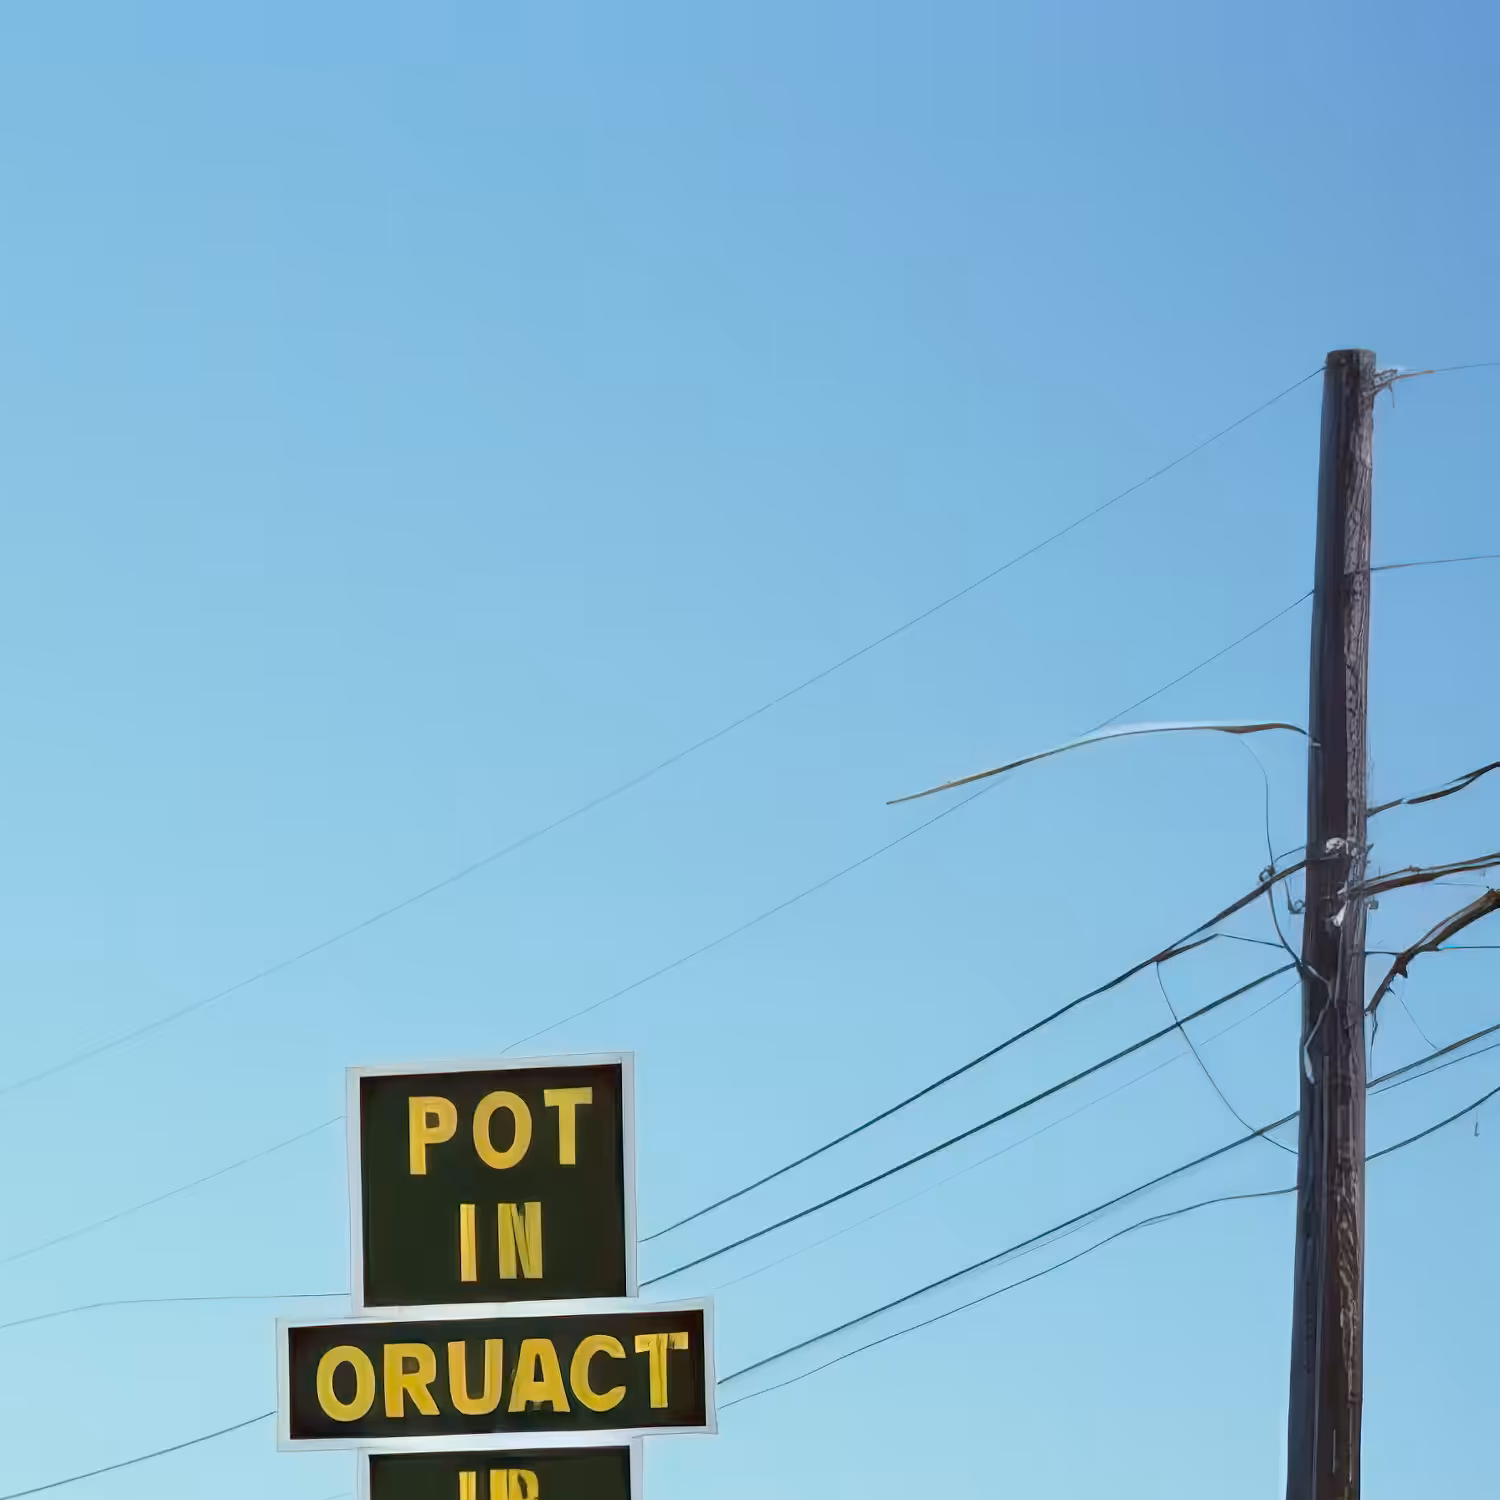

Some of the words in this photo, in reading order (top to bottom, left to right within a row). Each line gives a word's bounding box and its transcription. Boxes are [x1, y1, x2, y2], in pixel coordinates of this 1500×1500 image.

[408, 1086, 594, 1176] POT
[459, 1201, 544, 1283] IN
[315, 1331, 690, 1423] ORUACT
